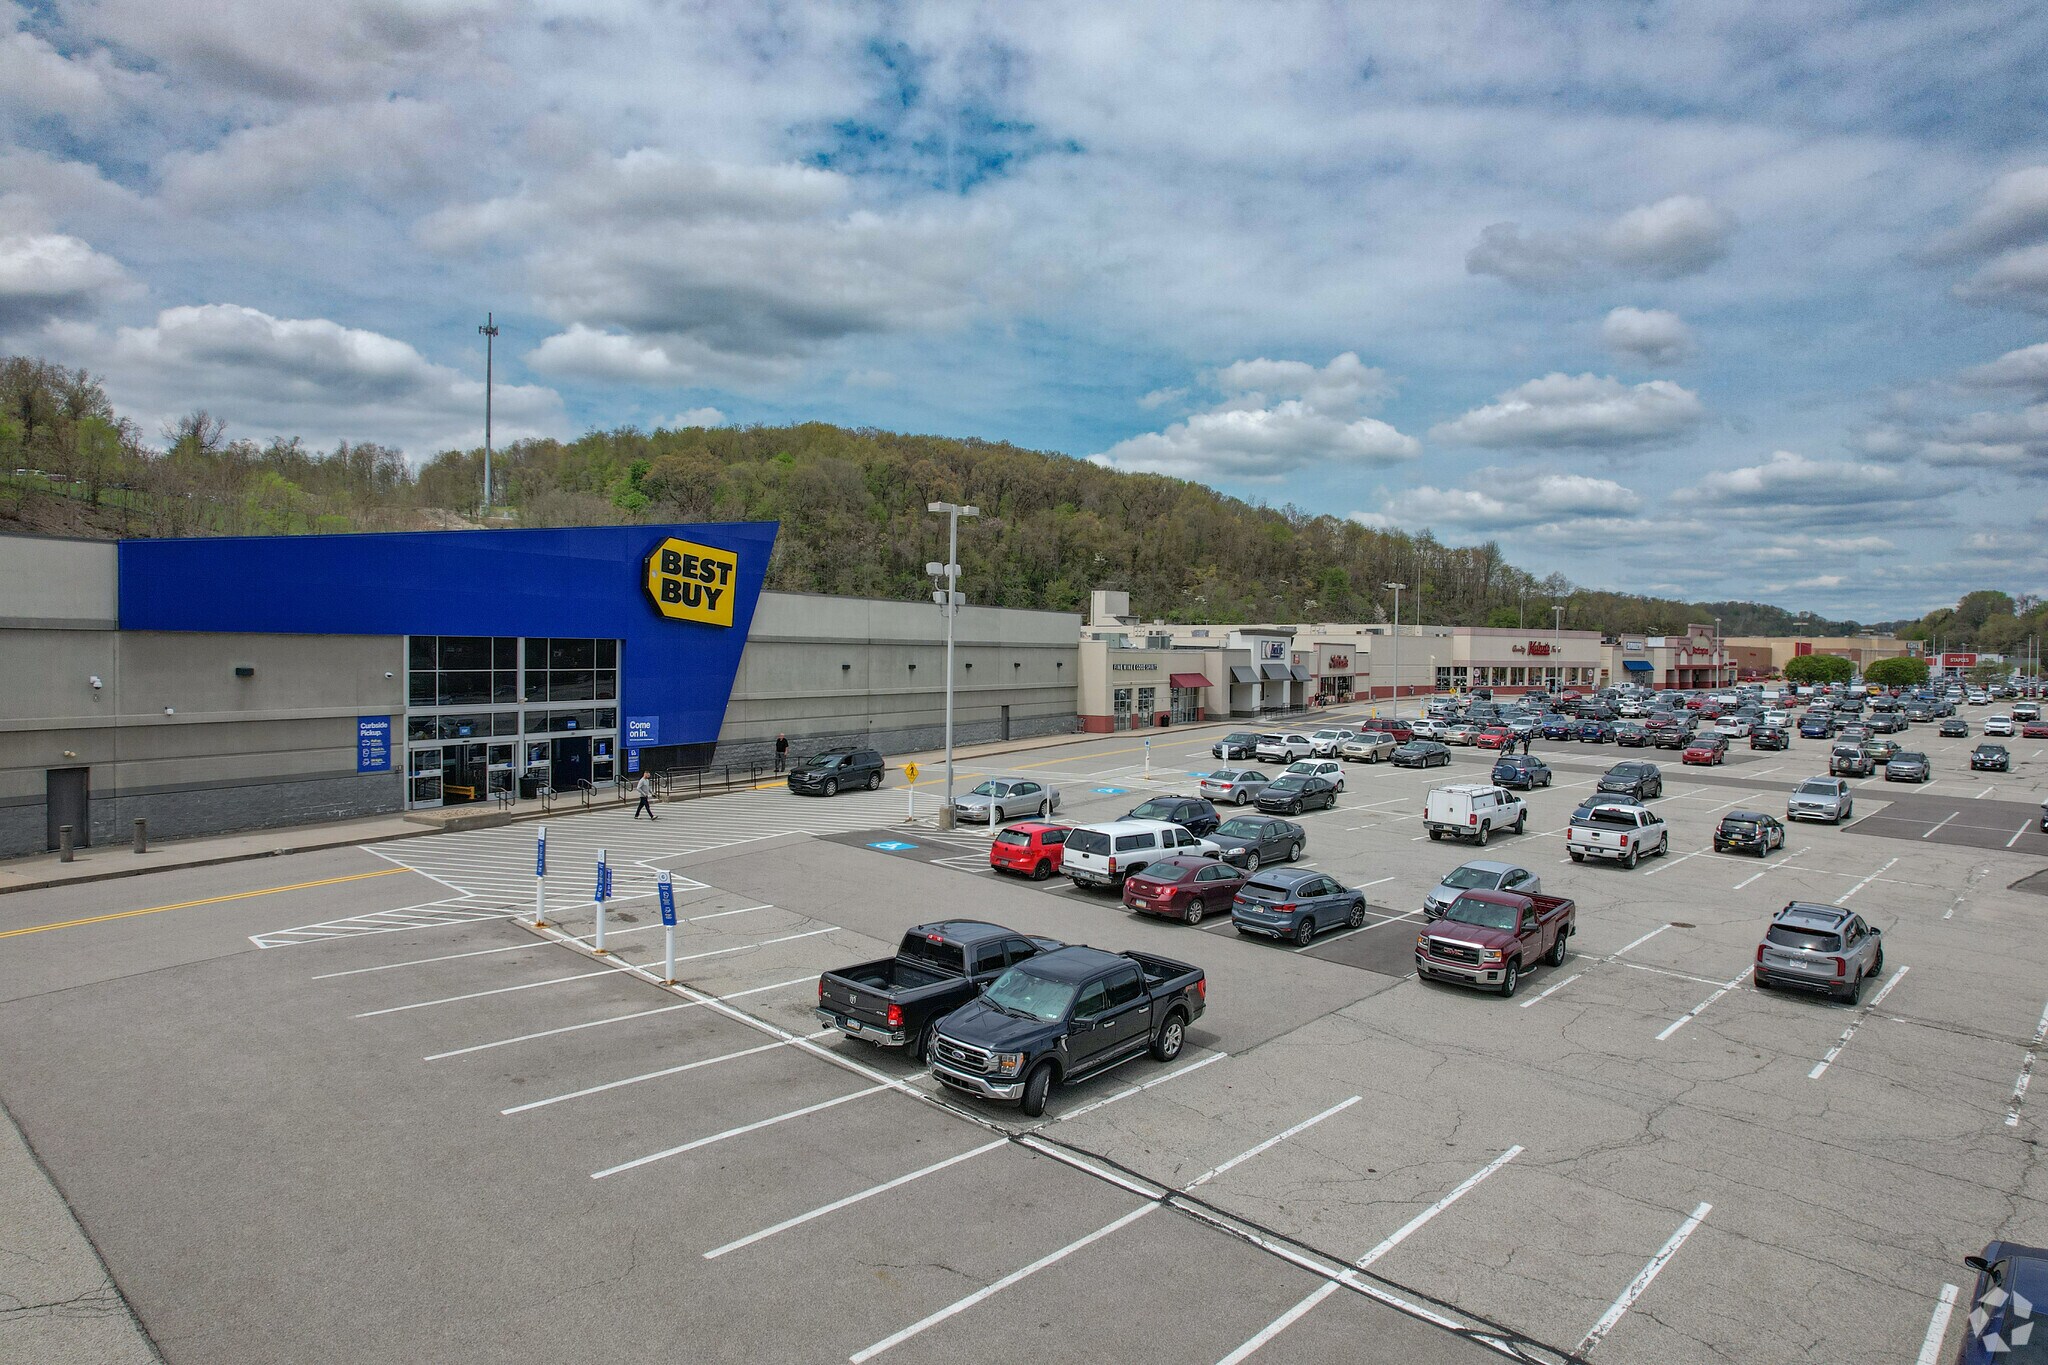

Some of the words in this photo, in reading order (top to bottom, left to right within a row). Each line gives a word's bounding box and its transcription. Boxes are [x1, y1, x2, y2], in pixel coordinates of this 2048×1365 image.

[661, 548, 733, 585] BEST
[661, 577, 724, 611] BUY
[629, 721, 651, 729] Come
[639, 729, 648, 737] in.
